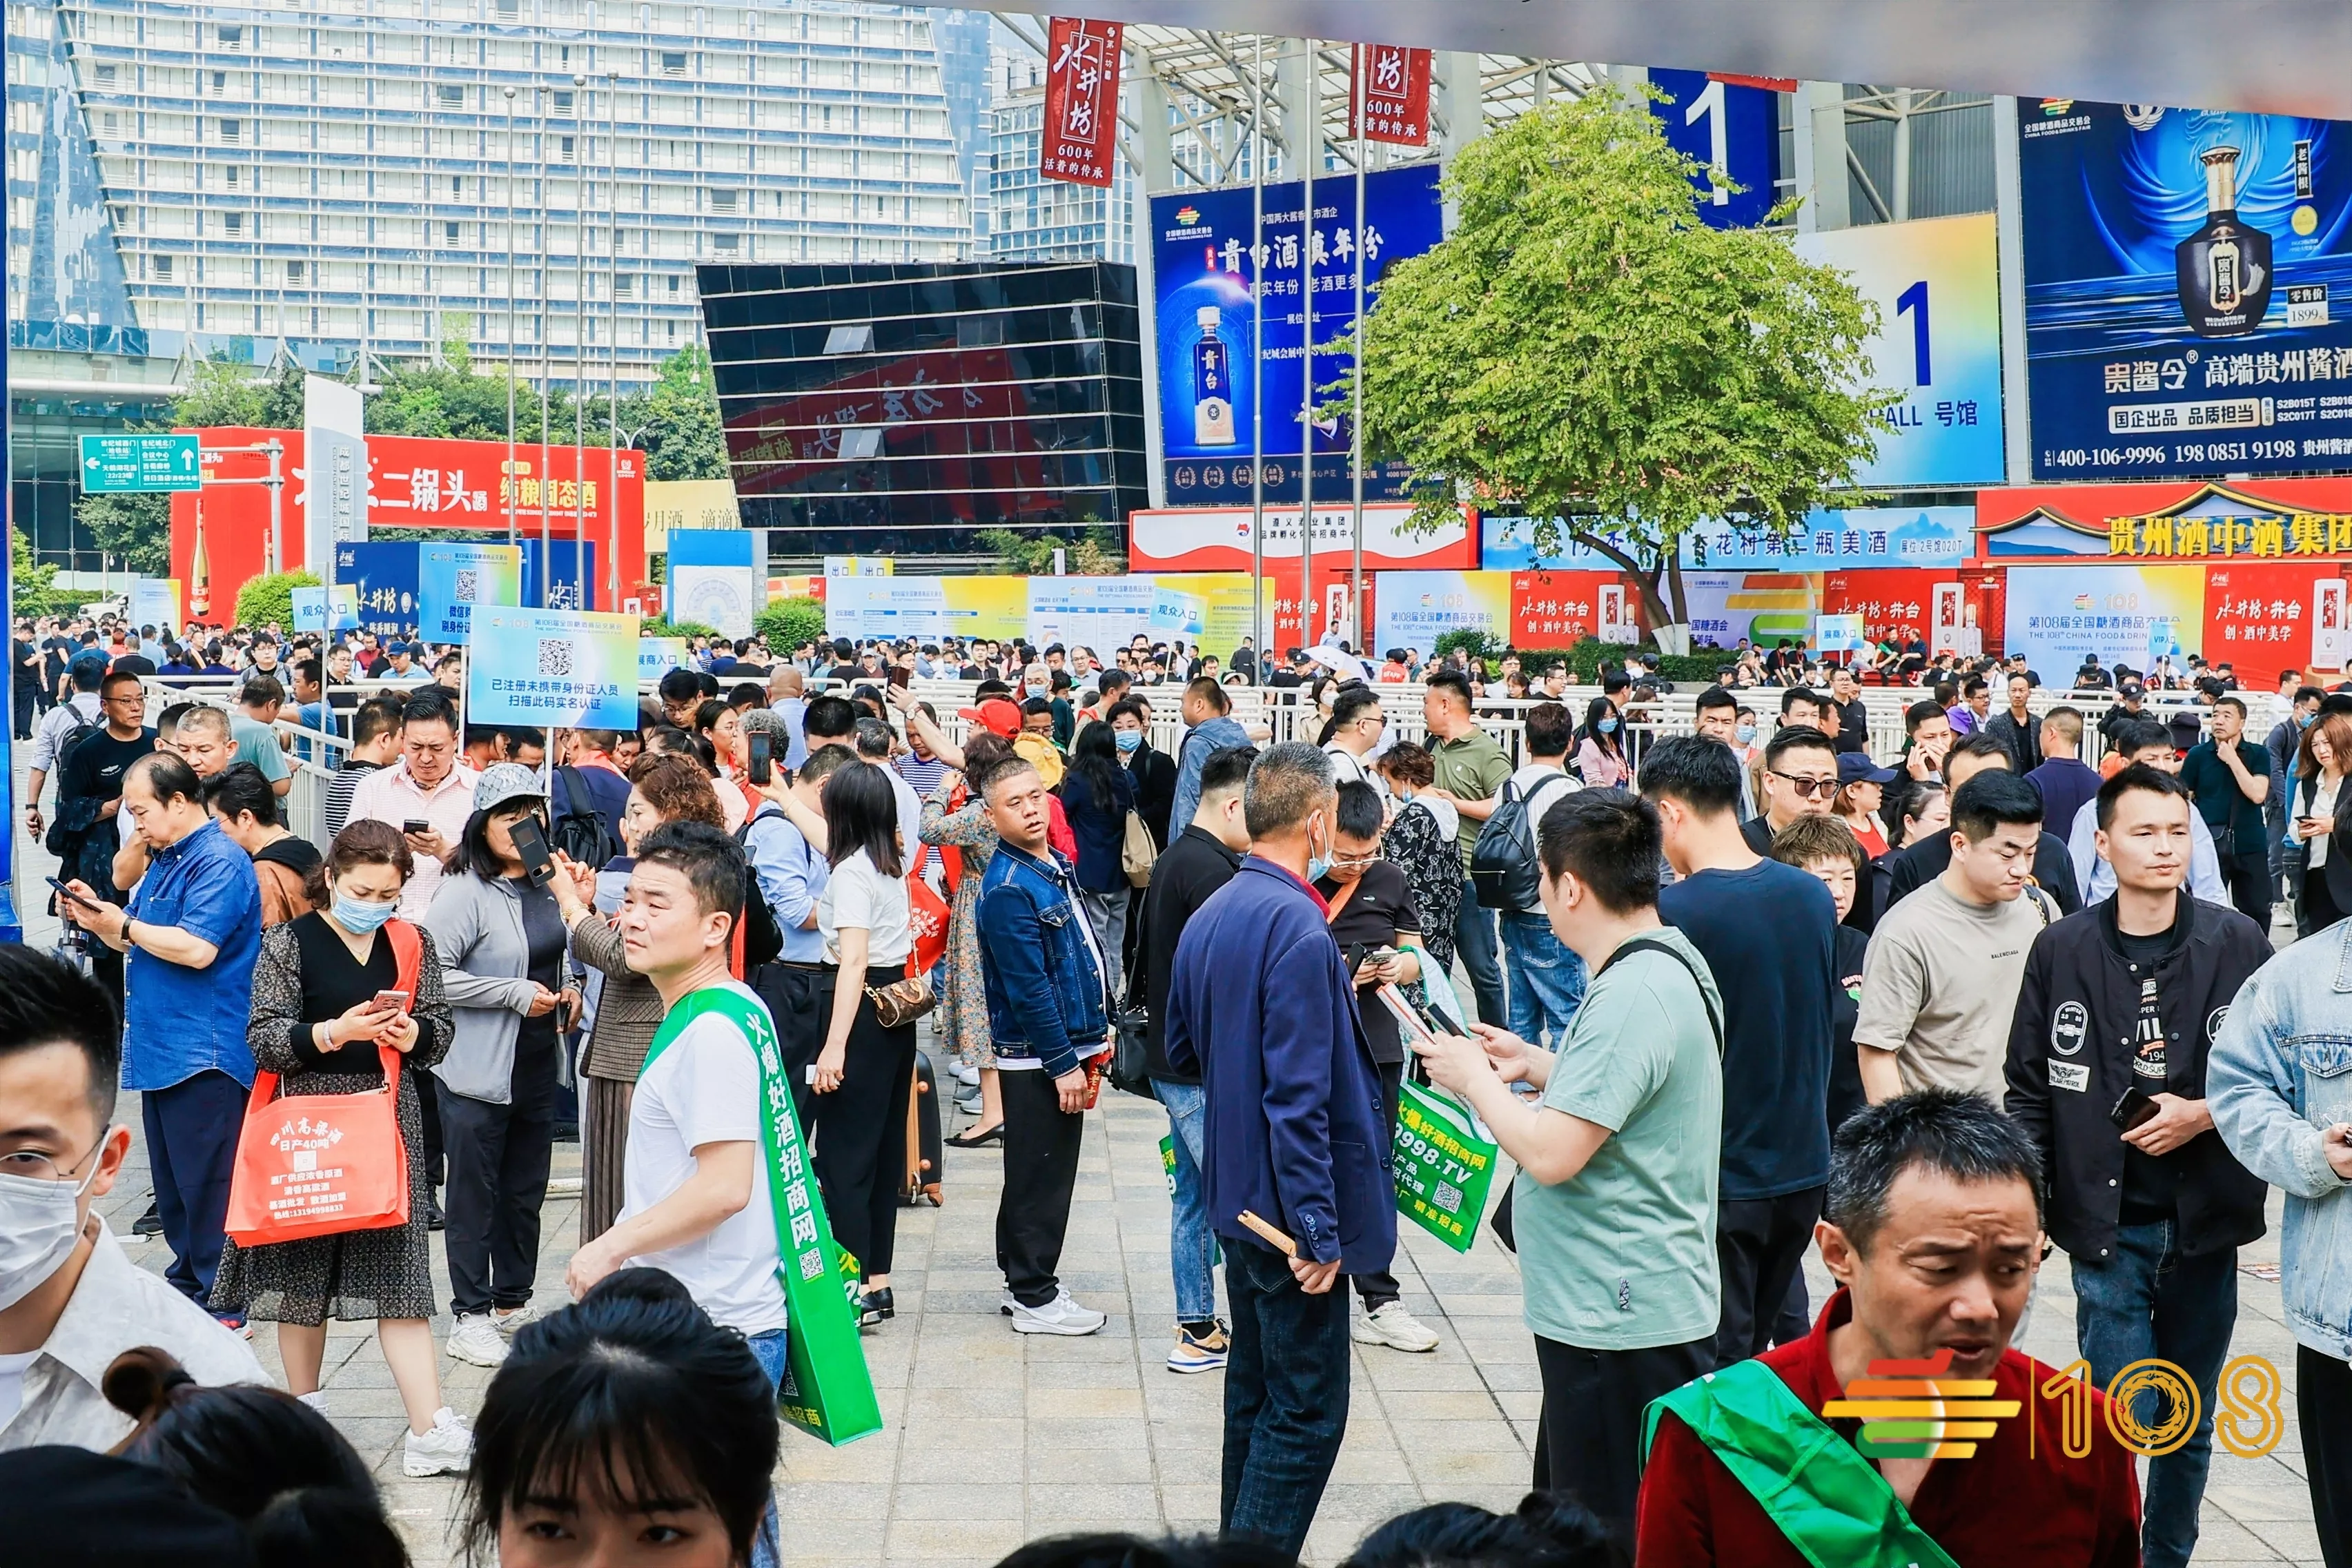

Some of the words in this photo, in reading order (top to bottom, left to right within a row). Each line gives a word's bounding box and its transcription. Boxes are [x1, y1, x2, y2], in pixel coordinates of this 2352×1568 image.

[1052, 19, 1099, 135] 水井坊
[1366, 100, 1404, 118] 600年
[2025, 116, 2090, 133] 全国糖酒商品交易会
[2041, 128, 2079, 136] FOOD&DRINKS
[1058, 144, 1093, 161] 600年
[1044, 157, 1104, 179] 活着的传承
[1262, 207, 1337, 224] 国两大酱香市酒企
[2291, 288, 2323, 302] 零售价
[1286, 313, 1321, 325] 展位址
[1897, 281, 1931, 386] 1
[2105, 358, 2188, 393] 贵酱令
[2205, 347, 2352, 388] 高端贵州酱酒
[2277, 398, 2315, 409] S2B015T
[1934, 400, 1978, 427] 号馆
[2114, 408, 2178, 429] 国企出品
[2188, 404, 2255, 426] 品质担当
[2277, 410, 2316, 422] S2C017T
[141, 440, 176, 448] 世纪城北门
[2057, 446, 2166, 467] 400-106-9996
[2175, 444, 2204, 463] 198
[2208, 442, 2247, 462] 0851
[2253, 440, 2297, 460] 9198
[2302, 438, 2352, 456] 贵州酱酒
[1291, 469, 1337, 478] 茅台核心产区
[340, 446, 351, 541] 成都世纪城国际
[380, 467, 471, 513] 二锅头
[499, 476, 597, 509] 纯粮固态酒
[2106, 513, 2352, 558] 贵州酒中酒集团
[1901, 539, 1963, 553] 展位:2号馆020T
[832, 565, 849, 576] 出口
[865, 566, 884, 577] 出口
[2104, 593, 2138, 611] 108
[303, 604, 347, 617] 观众入口
[1158, 605, 1197, 620] 观众入口
[1391, 611, 1493, 623] 第108届全国糖酒商品交易会
[509, 618, 529, 629] 108
[534, 618, 623, 632] 第108届全国糖酒商品交易会
[1824, 629, 1857, 639] 展商入口
[1864, 625, 1912, 638] 酒中学
[2154, 635, 2176, 645] VIP入口
[638, 654, 677, 666] 展商入口
[492, 678, 619, 696] 已注册未携带身份证人员
[509, 694, 602, 710] 扫描此码实名认证
[1991, 950, 2019, 959] BALENCIAGA
[2064, 1006, 2083, 1016] WINTER
[744, 1011, 819, 1251] 火爆好酒招商网
[1398, 1100, 1487, 1171] 火爆好酒招商网
[280, 1137, 330, 1152] 日产40吨
[1413, 1198, 1464, 1237] 精准招商
